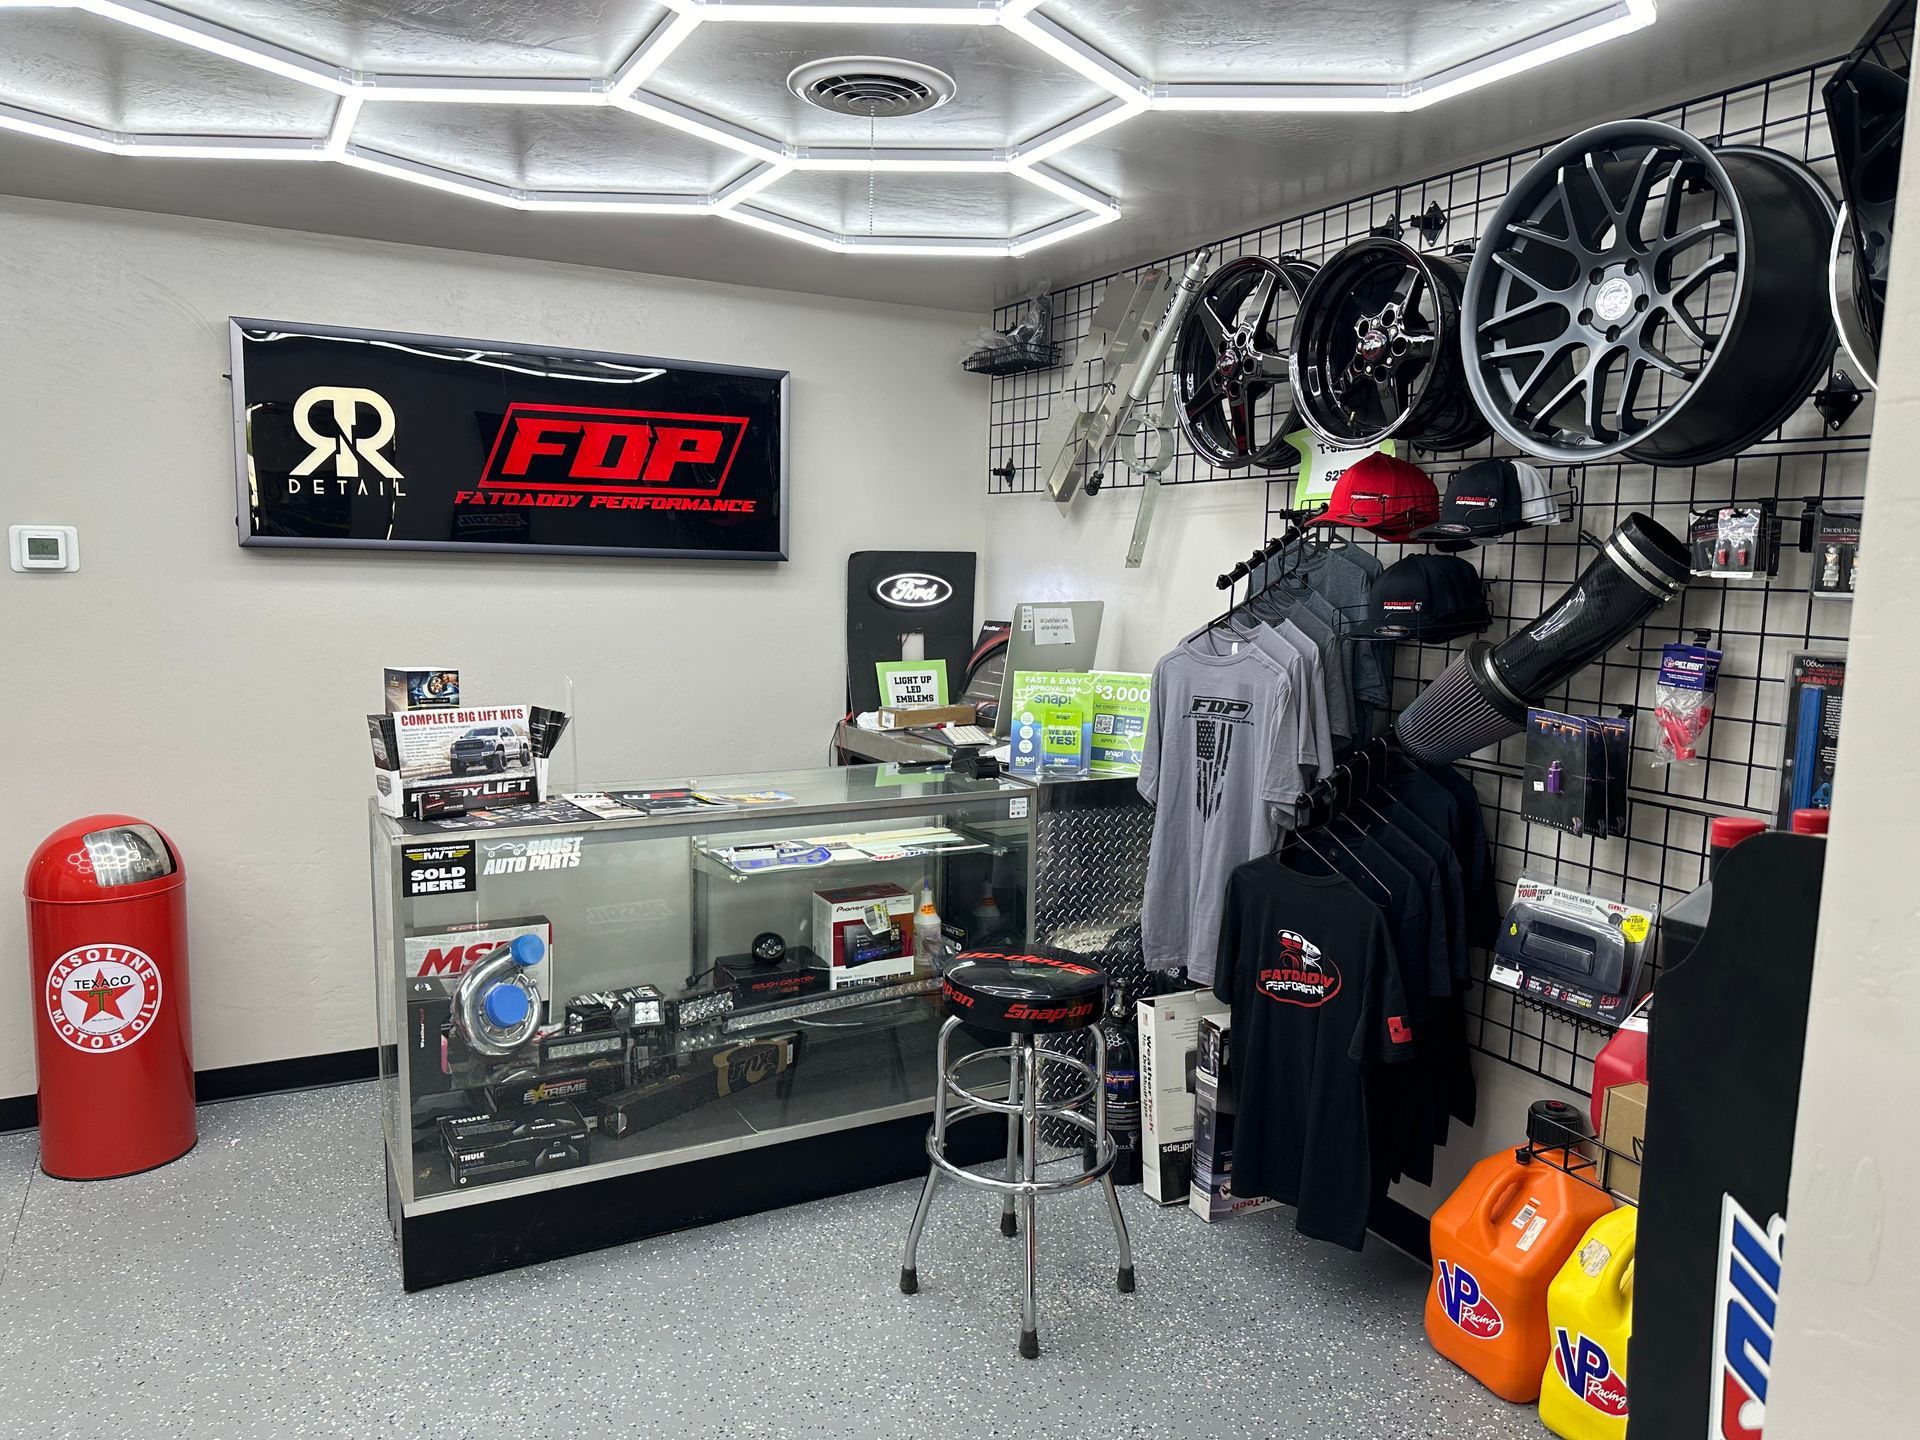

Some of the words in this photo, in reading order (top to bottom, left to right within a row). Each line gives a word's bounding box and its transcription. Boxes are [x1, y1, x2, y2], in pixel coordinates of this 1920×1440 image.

[501, 417, 723, 481] FDP
[288, 479, 406, 496] DETAIL
[453, 490, 584, 508] FATDADDY
[589, 495, 757, 513] PERFORMANCE
[891, 578, 938, 600] Ford
[894, 676, 919, 685] LIGHT
[919, 675, 932, 684] UP
[1025, 676, 1049, 684] FAST
[1061, 677, 1083, 685] EASY
[906, 685, 922, 694] LED
[1025, 684, 1066, 693] APPROVAL
[1095, 684, 1151, 703] $3,000
[895, 694, 935, 703] EMBLEMS
[1034, 693, 1072, 708] snap!
[1191, 698, 1249, 715] FDP
[401, 712, 456, 727] COMPLETE
[457, 711, 476, 723] BIG
[477, 709, 499, 722] LIFT
[500, 708, 524, 720] KITS
[1048, 736, 1076, 746] YES!
[1061, 729, 1077, 737] SAY
[526, 836, 584, 857] BOOST
[423, 850, 457, 860] M/T
[483, 856, 528, 876] AUTO
[528, 851, 582, 872] PARTS
[411, 866, 466, 881] SOLD
[412, 878, 466, 894] HERE
[1518, 888, 1538, 898] YOUR
[1537, 888, 1553, 896] TRUCK
[1579, 897, 1596, 907] HANDLE
[417, 940, 511, 977] MS
[51, 948, 155, 989] GASOLINE
[74, 975, 131, 990] TEXACO
[752, 981, 779, 991] ROUGH
[779, 975, 816, 987] COUNTRY
[1543, 985, 1552, 996] 2
[1560, 991, 1568, 1001] 3
[1600, 994, 1621, 1006] Easy
[1003, 1003, 1094, 1023] Snap-on
[52, 1008, 126, 1049] MOTOR
[131, 999, 157, 1031] OIL
[1146, 1034, 1155, 1135] WeatherTech
[460, 1151, 485, 1162] THULE
[548, 1151, 566, 1160] THULE
[1439, 1260, 1481, 1326] VP
[1462, 1306, 1502, 1332] Racing
[1557, 1329, 1610, 1400] VP
[1588, 1380, 1627, 1409] Racing
